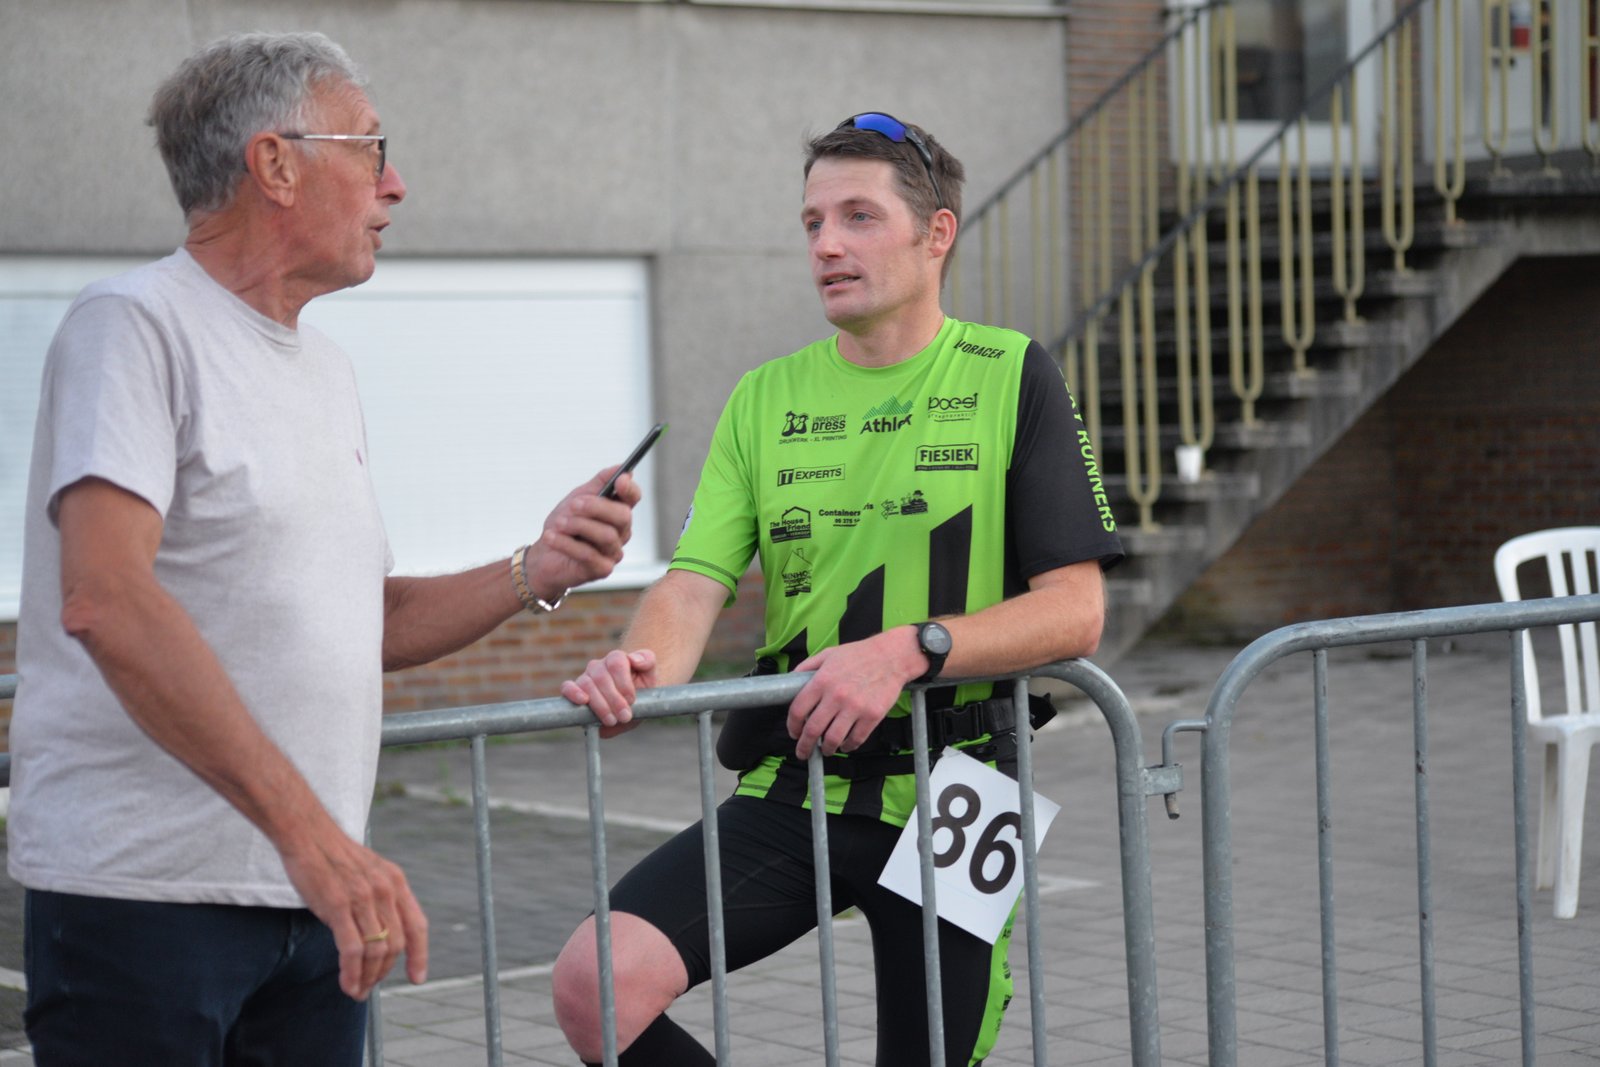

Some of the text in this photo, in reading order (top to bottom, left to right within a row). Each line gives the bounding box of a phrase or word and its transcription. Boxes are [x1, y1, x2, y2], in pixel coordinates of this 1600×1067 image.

[953, 339, 1005, 359] VORACER
[811, 420, 846, 433] press
[920, 448, 974, 462] FIESIEK
[795, 468, 842, 480] EXPERTS
[782, 518, 804, 526] House
[918, 783, 1022, 894] 86
